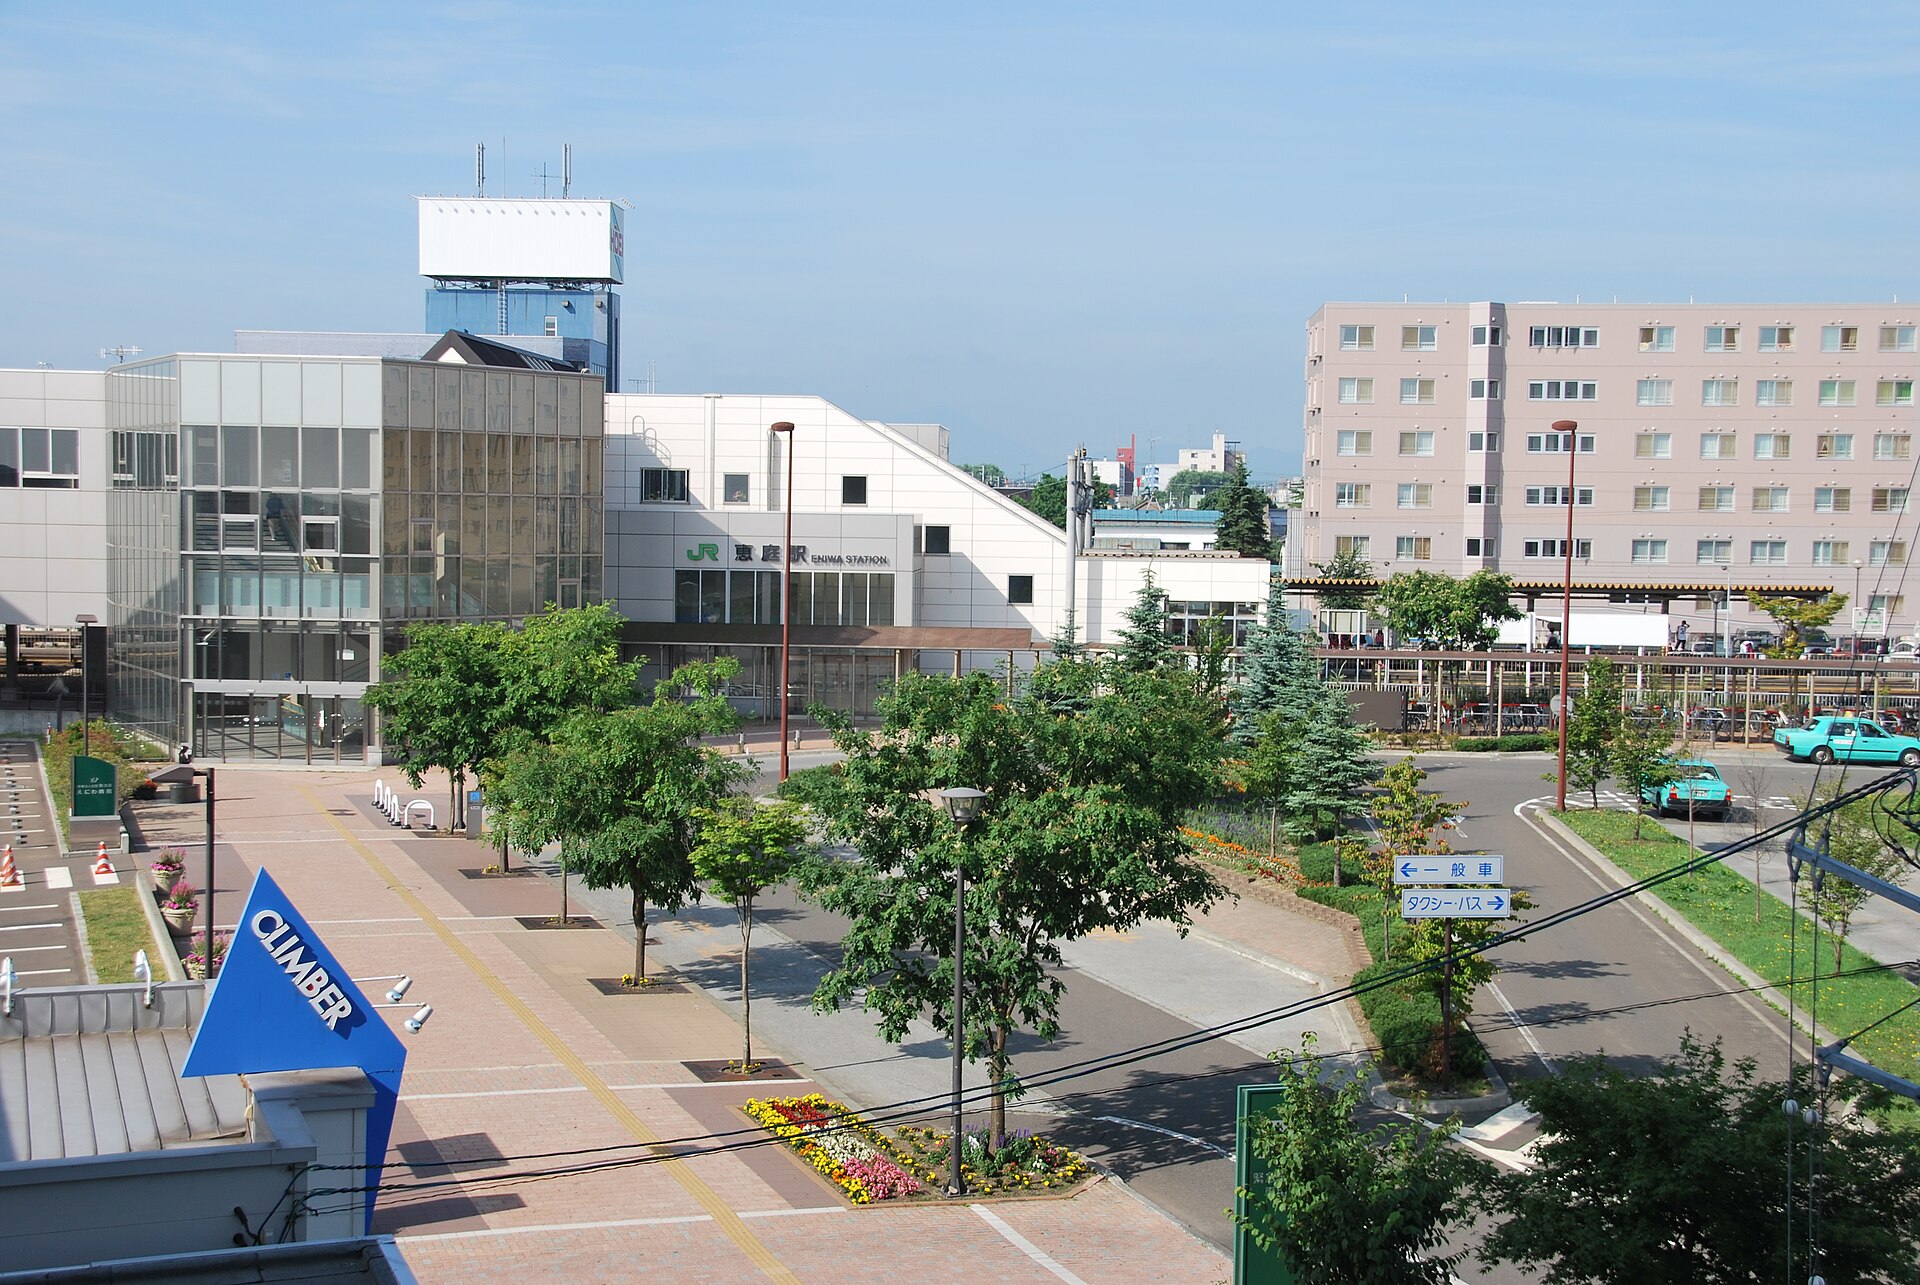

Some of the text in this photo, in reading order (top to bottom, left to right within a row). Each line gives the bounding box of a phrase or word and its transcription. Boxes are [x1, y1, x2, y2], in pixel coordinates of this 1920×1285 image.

[687, 544, 719, 561] JR
[734, 544, 807, 563] 恵庭駅
[811, 554, 888, 565] ENIWA STATION
[1424, 862, 1493, 877] 一般車
[1407, 897, 1482, 911] タクシー・バス
[252, 909, 352, 1031] CLIMBER
